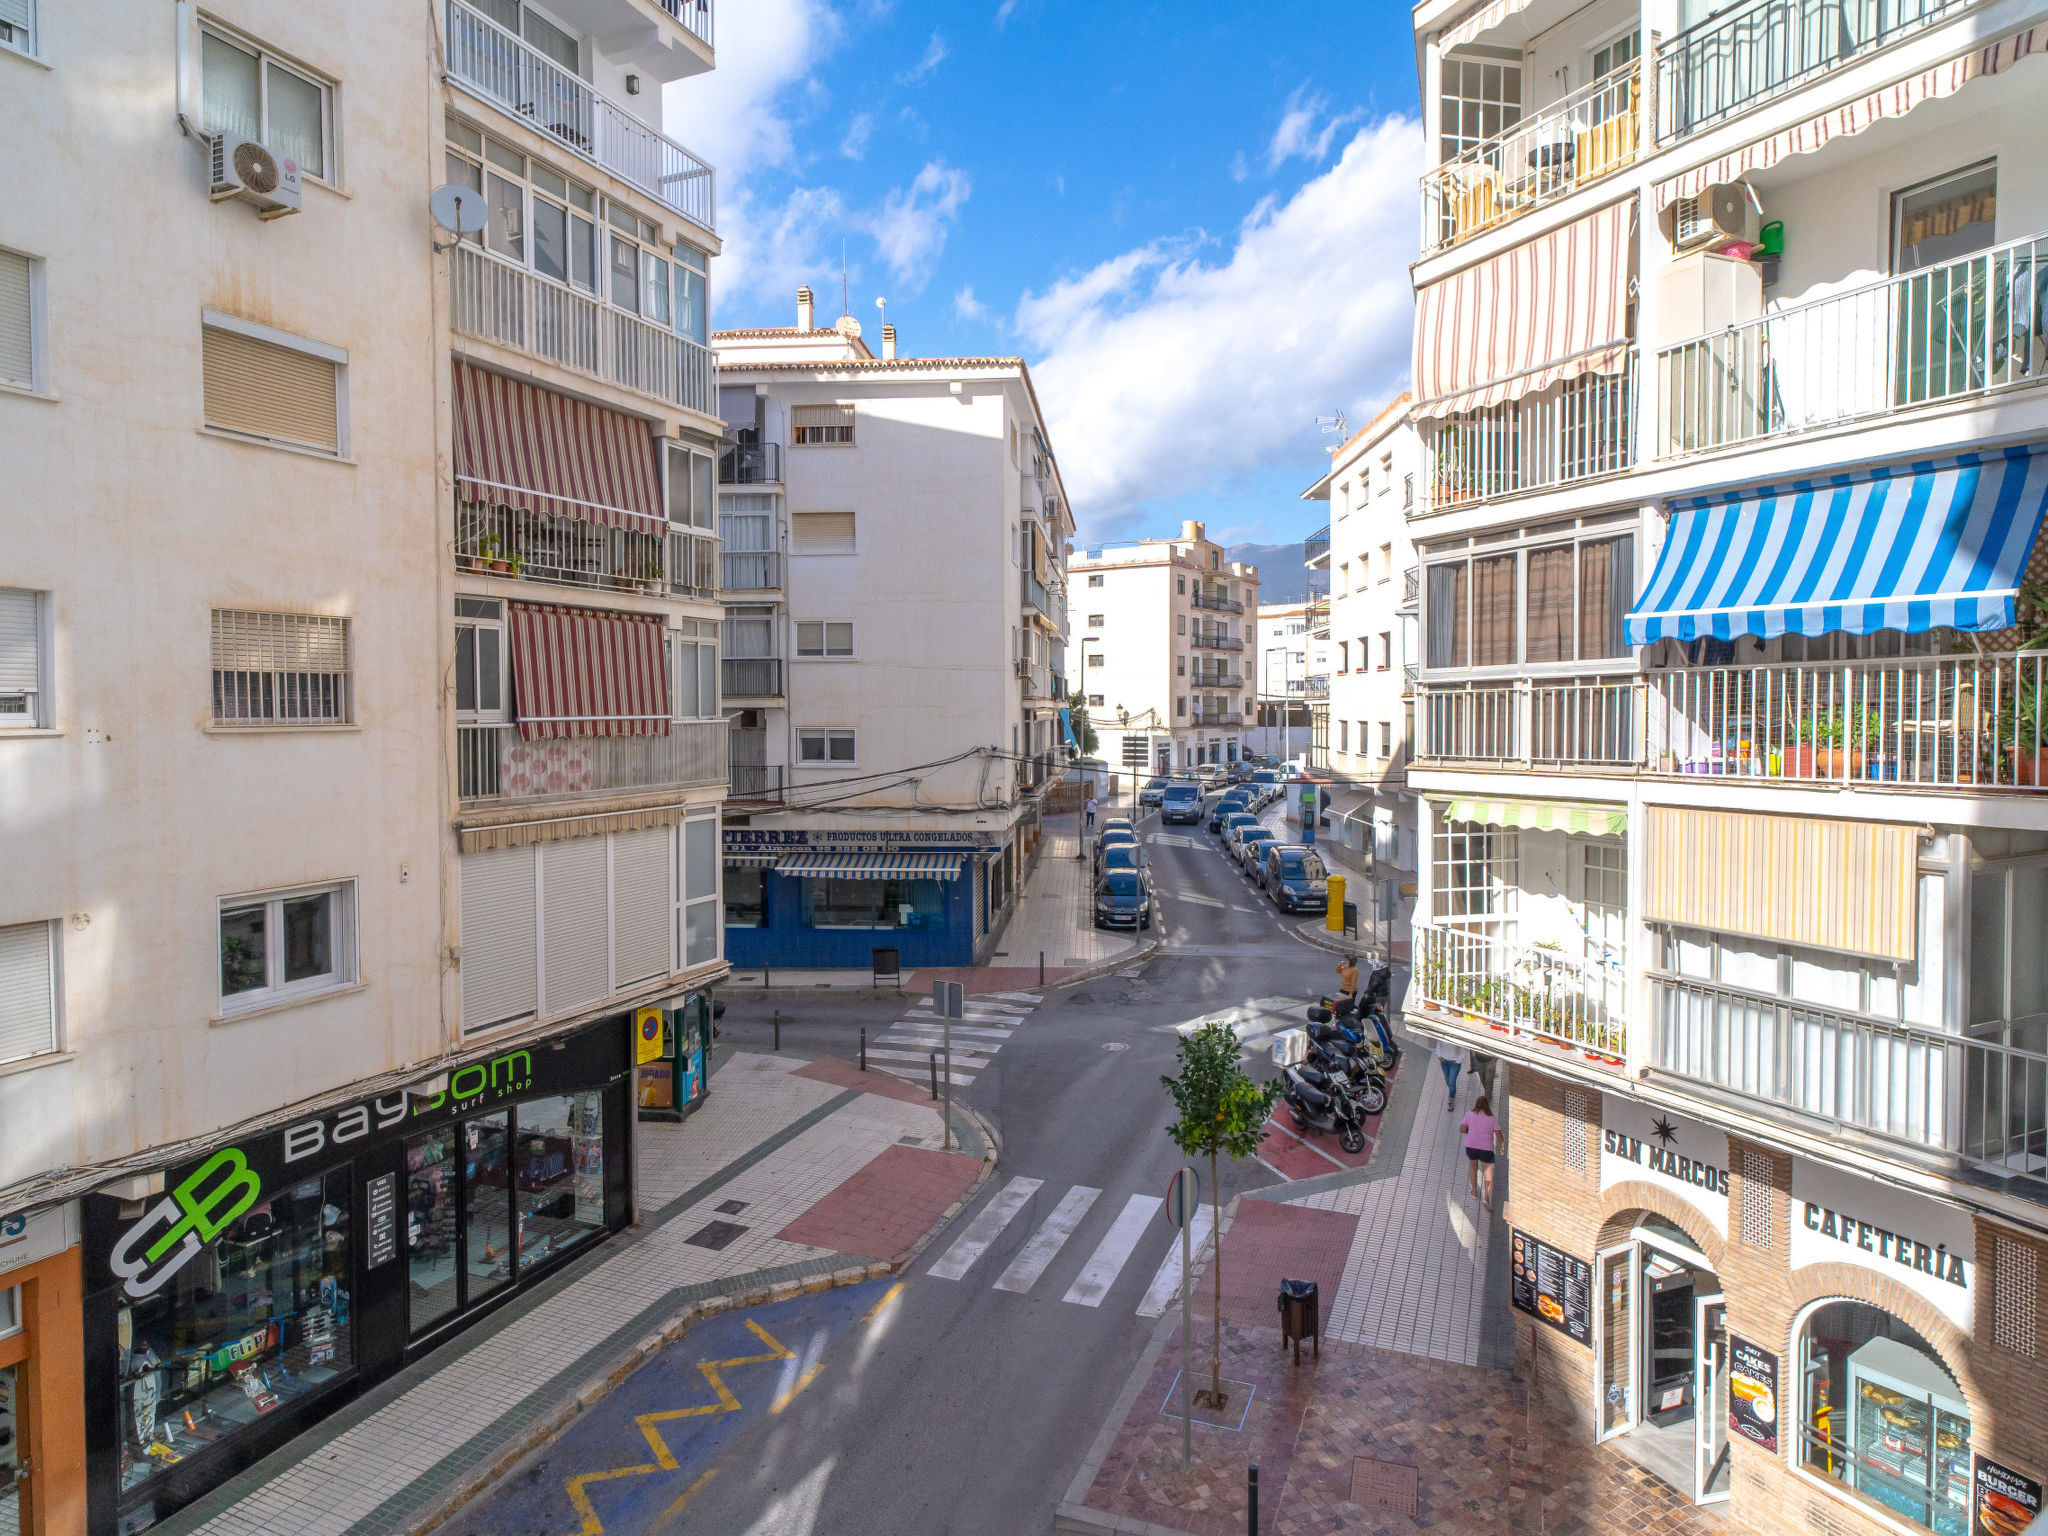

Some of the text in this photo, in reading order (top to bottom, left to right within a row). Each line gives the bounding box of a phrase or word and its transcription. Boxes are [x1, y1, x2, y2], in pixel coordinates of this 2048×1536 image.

[285, 173, 296, 183] LG
[826, 832, 877, 842] PRODUCTOS
[880, 832, 911, 842] ULTRA
[913, 832, 973, 842] CONGELADOS
[640, 1068, 670, 1080] JUGADO
[452, 1078, 533, 1115] surf shop
[1604, 1128, 1730, 1197] SAN MARCOS
[1803, 1201, 1968, 1289] CAFETERÍA
[1735, 1350, 1771, 1372] CAKES
[1977, 1469, 2037, 1507] BURGER
[1987, 1465, 2028, 1489] HOMEMADE
